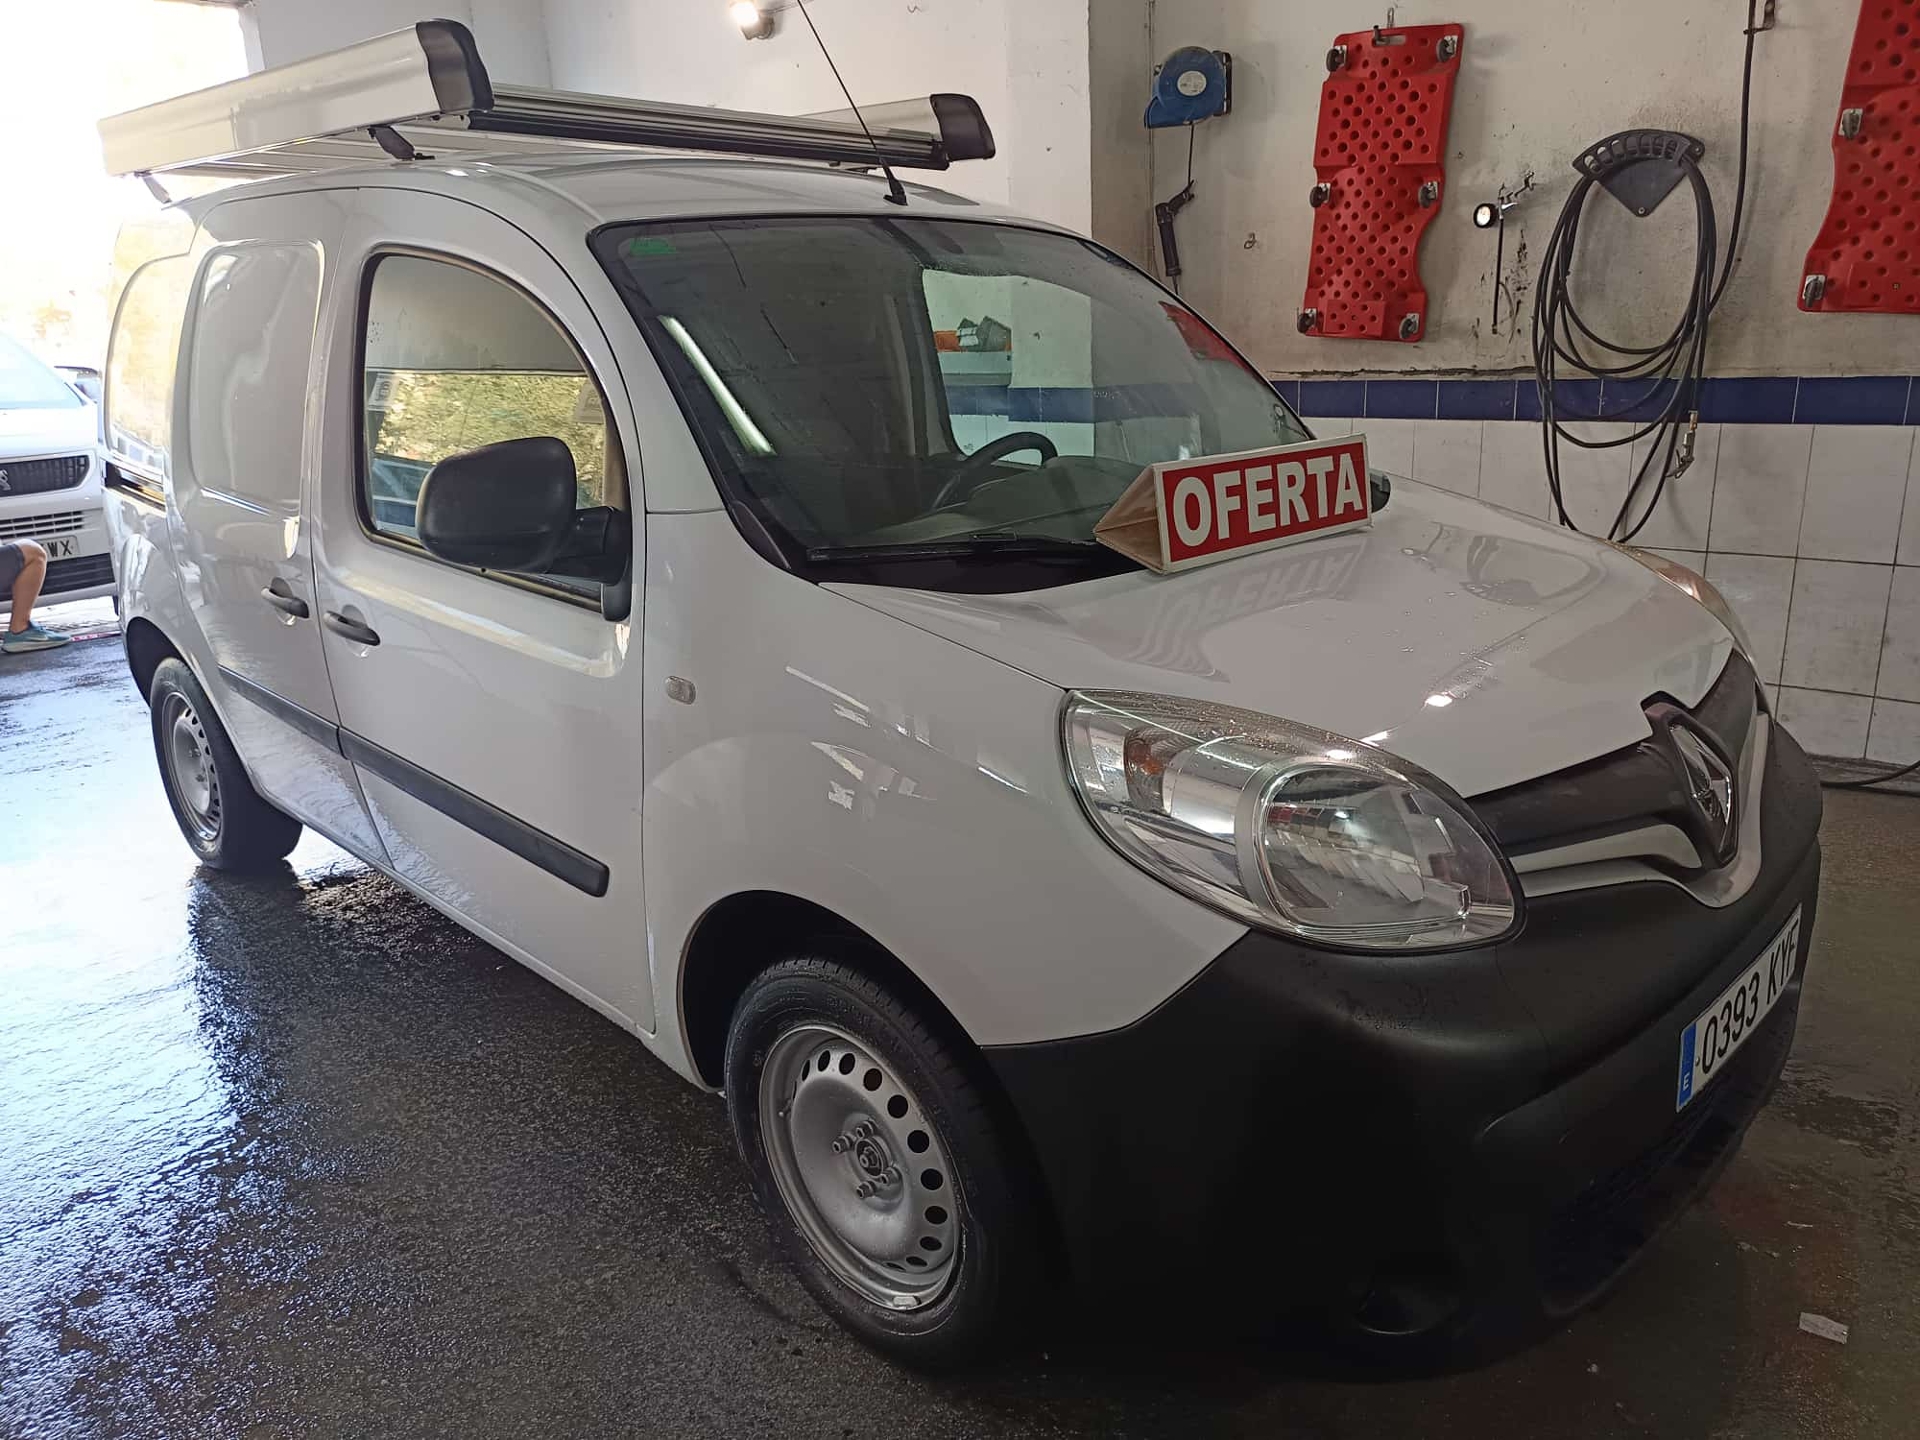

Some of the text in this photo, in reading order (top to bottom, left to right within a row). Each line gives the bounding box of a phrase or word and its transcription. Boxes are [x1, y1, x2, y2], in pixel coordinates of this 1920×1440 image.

[1172, 452, 1364, 548] OFERTA
[41, 540, 72, 558] WX
[1682, 918, 1799, 1091] E 0393 KYF
